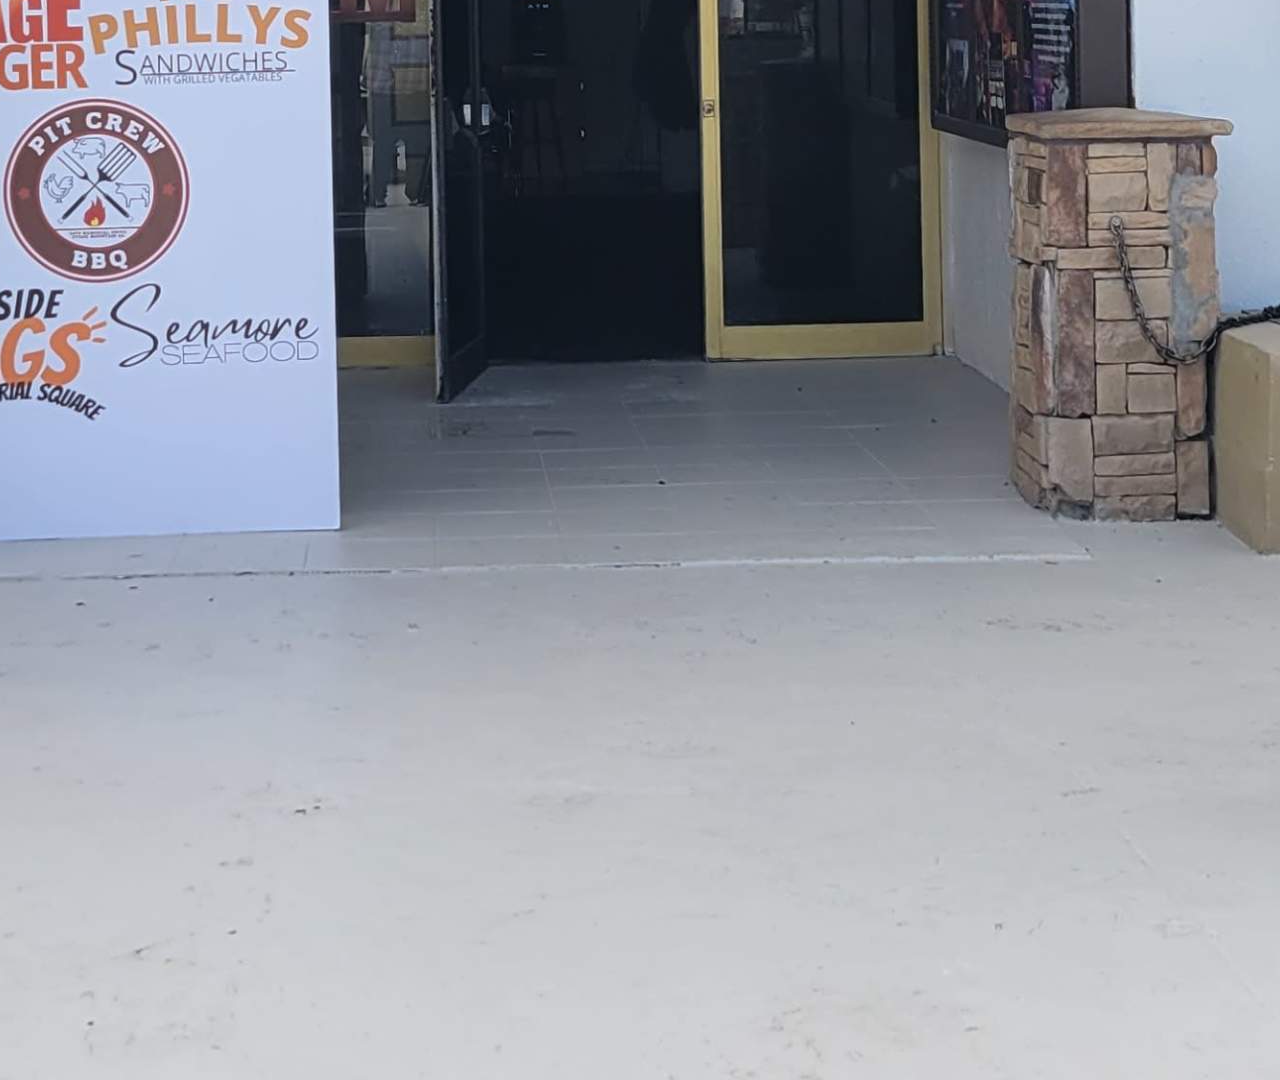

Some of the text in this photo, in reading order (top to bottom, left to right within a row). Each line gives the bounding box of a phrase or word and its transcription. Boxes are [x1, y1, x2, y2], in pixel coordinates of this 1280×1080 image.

[88, 3, 312, 55] PHILLYS
[115, 50, 288, 85] SANDWICHES
[144, 72, 283, 85] WITH GRILLED VEGATABLES
[28, 111, 166, 157] PIT CREW
[71, 249, 129, 270] BBQ
[110, 283, 319, 368] Seamore
[160, 340, 320, 366] SEAFOOD
[37, 383, 107, 421] SQUARE
